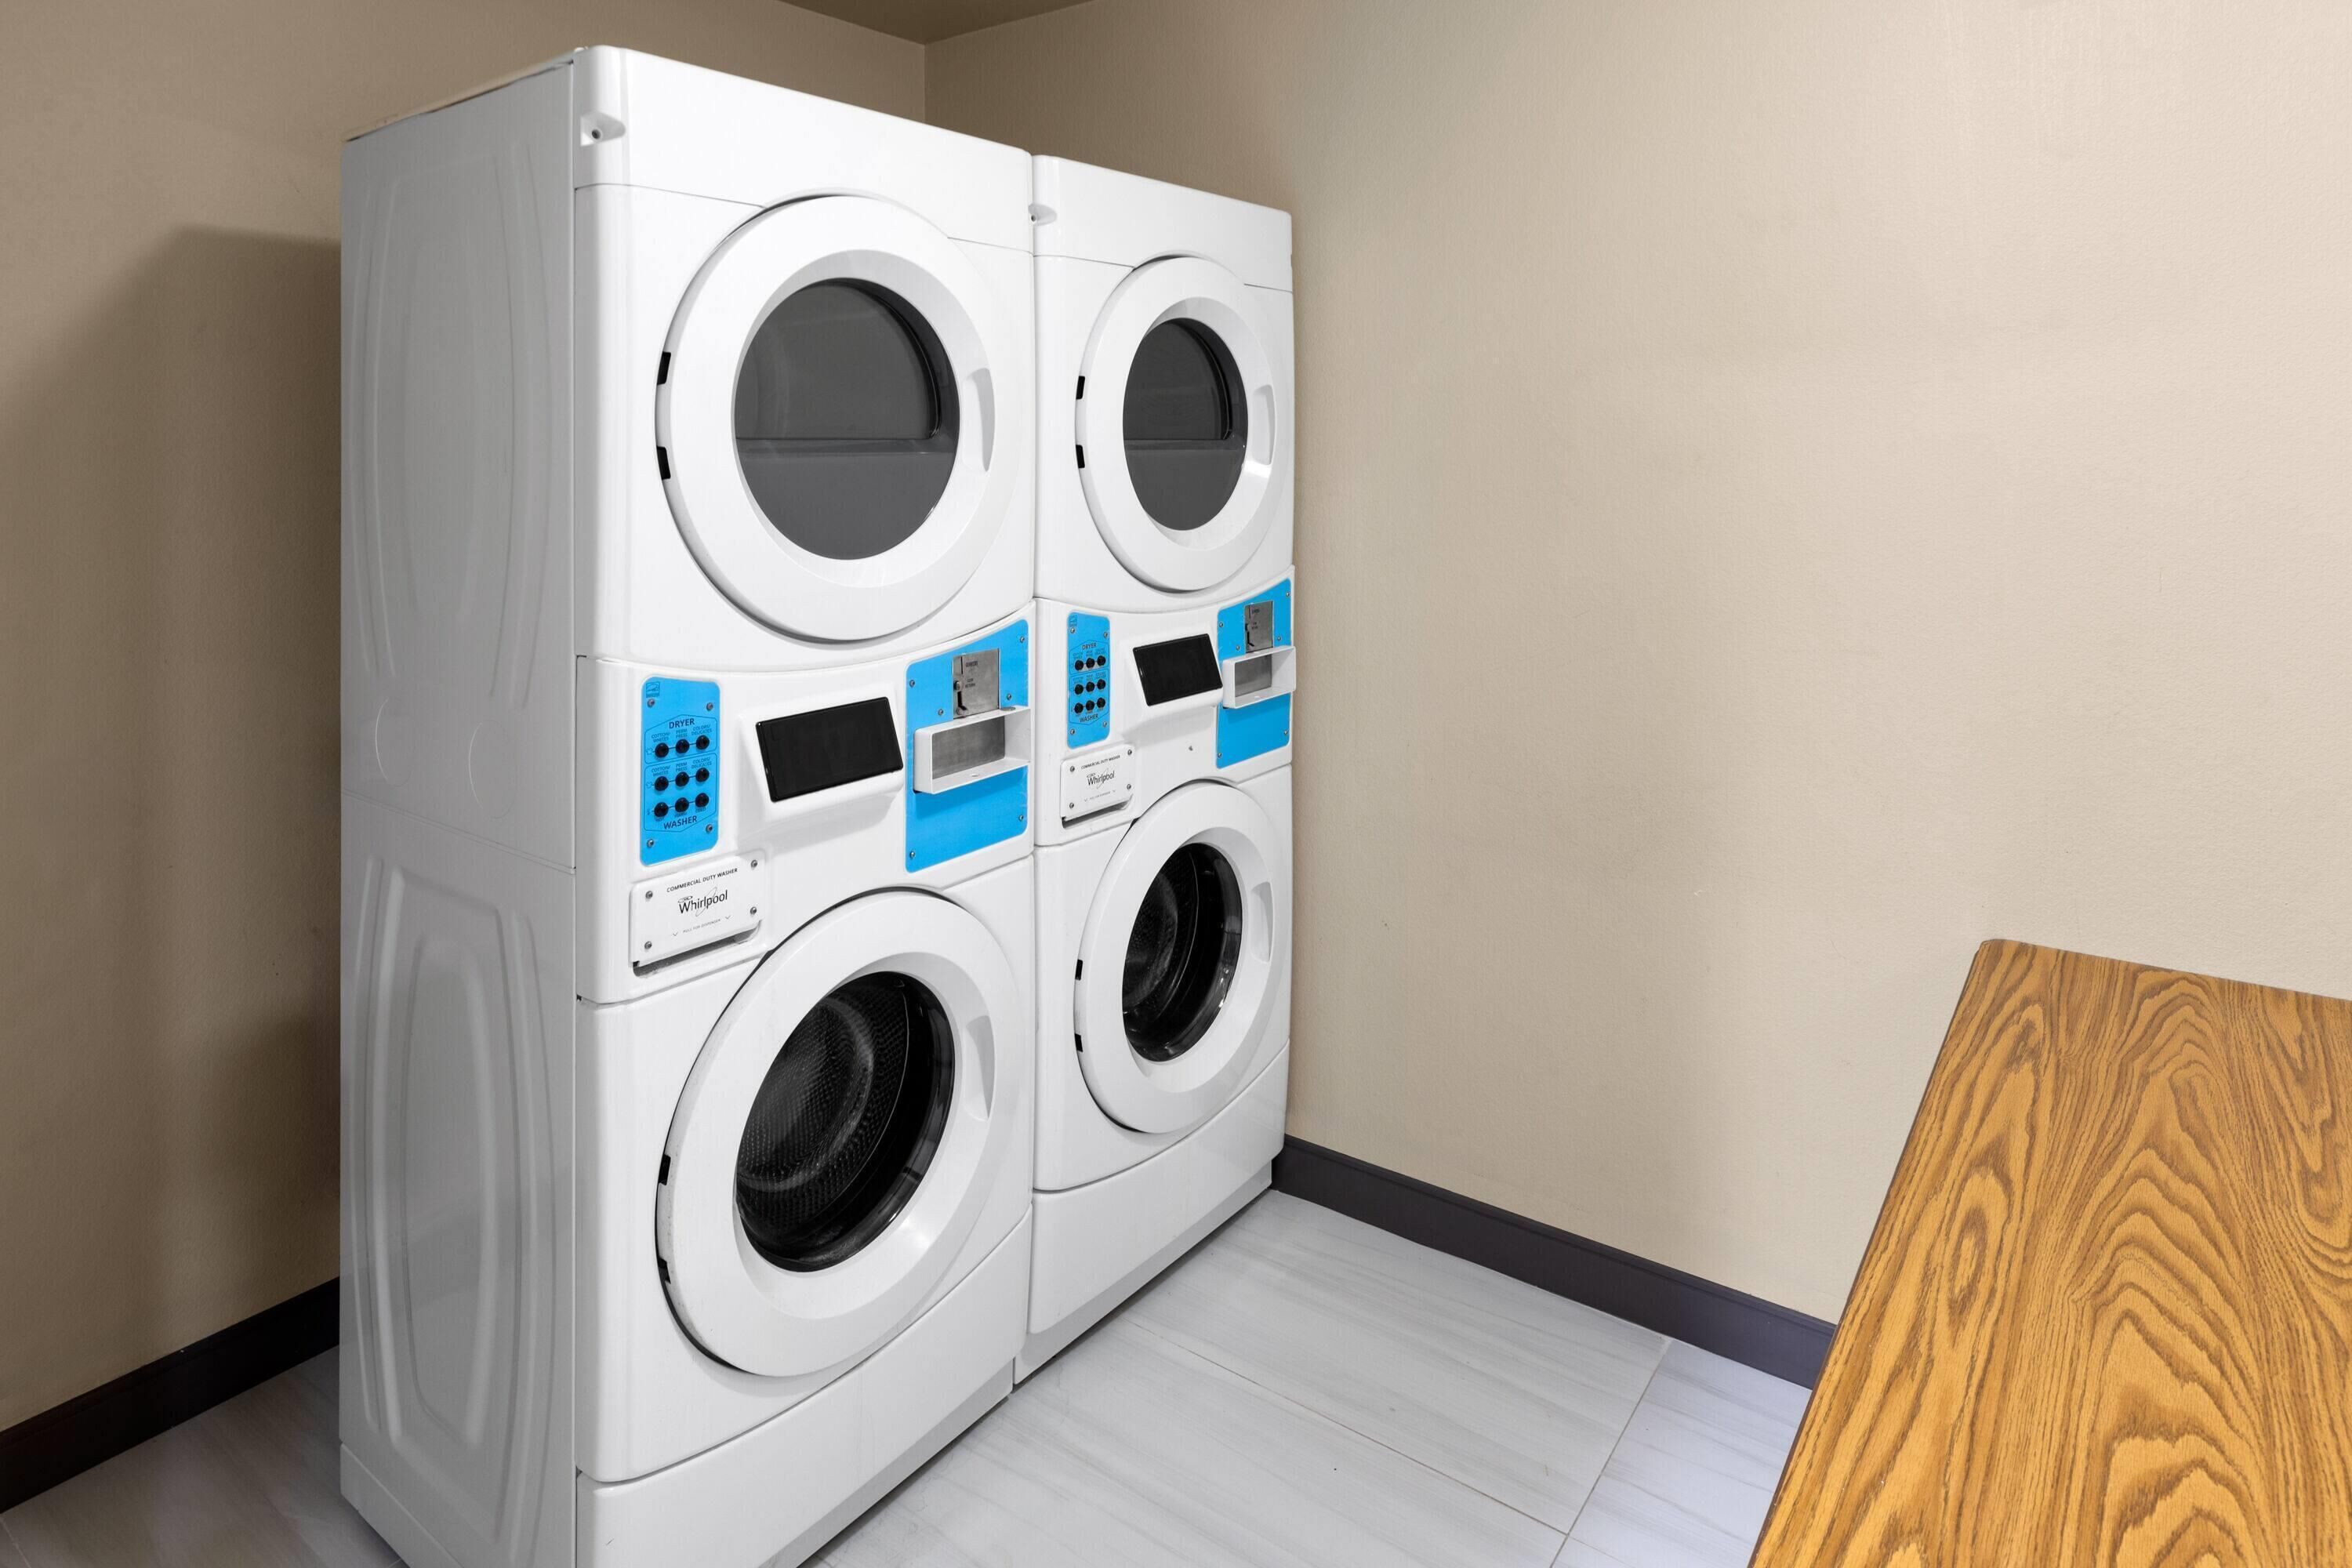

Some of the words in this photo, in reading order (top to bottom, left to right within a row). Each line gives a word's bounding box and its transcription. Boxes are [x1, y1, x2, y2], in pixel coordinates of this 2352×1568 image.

[669, 718, 695, 728] DRYER
[1080, 713, 1098, 722] WASHER
[1087, 770, 1115, 786] Whirlpool
[663, 815, 697, 829] WASHER
[666, 879, 702, 893] COMMERCIAL
[717, 868, 738, 878] WASHER
[679, 889, 728, 913] Whirlpool
